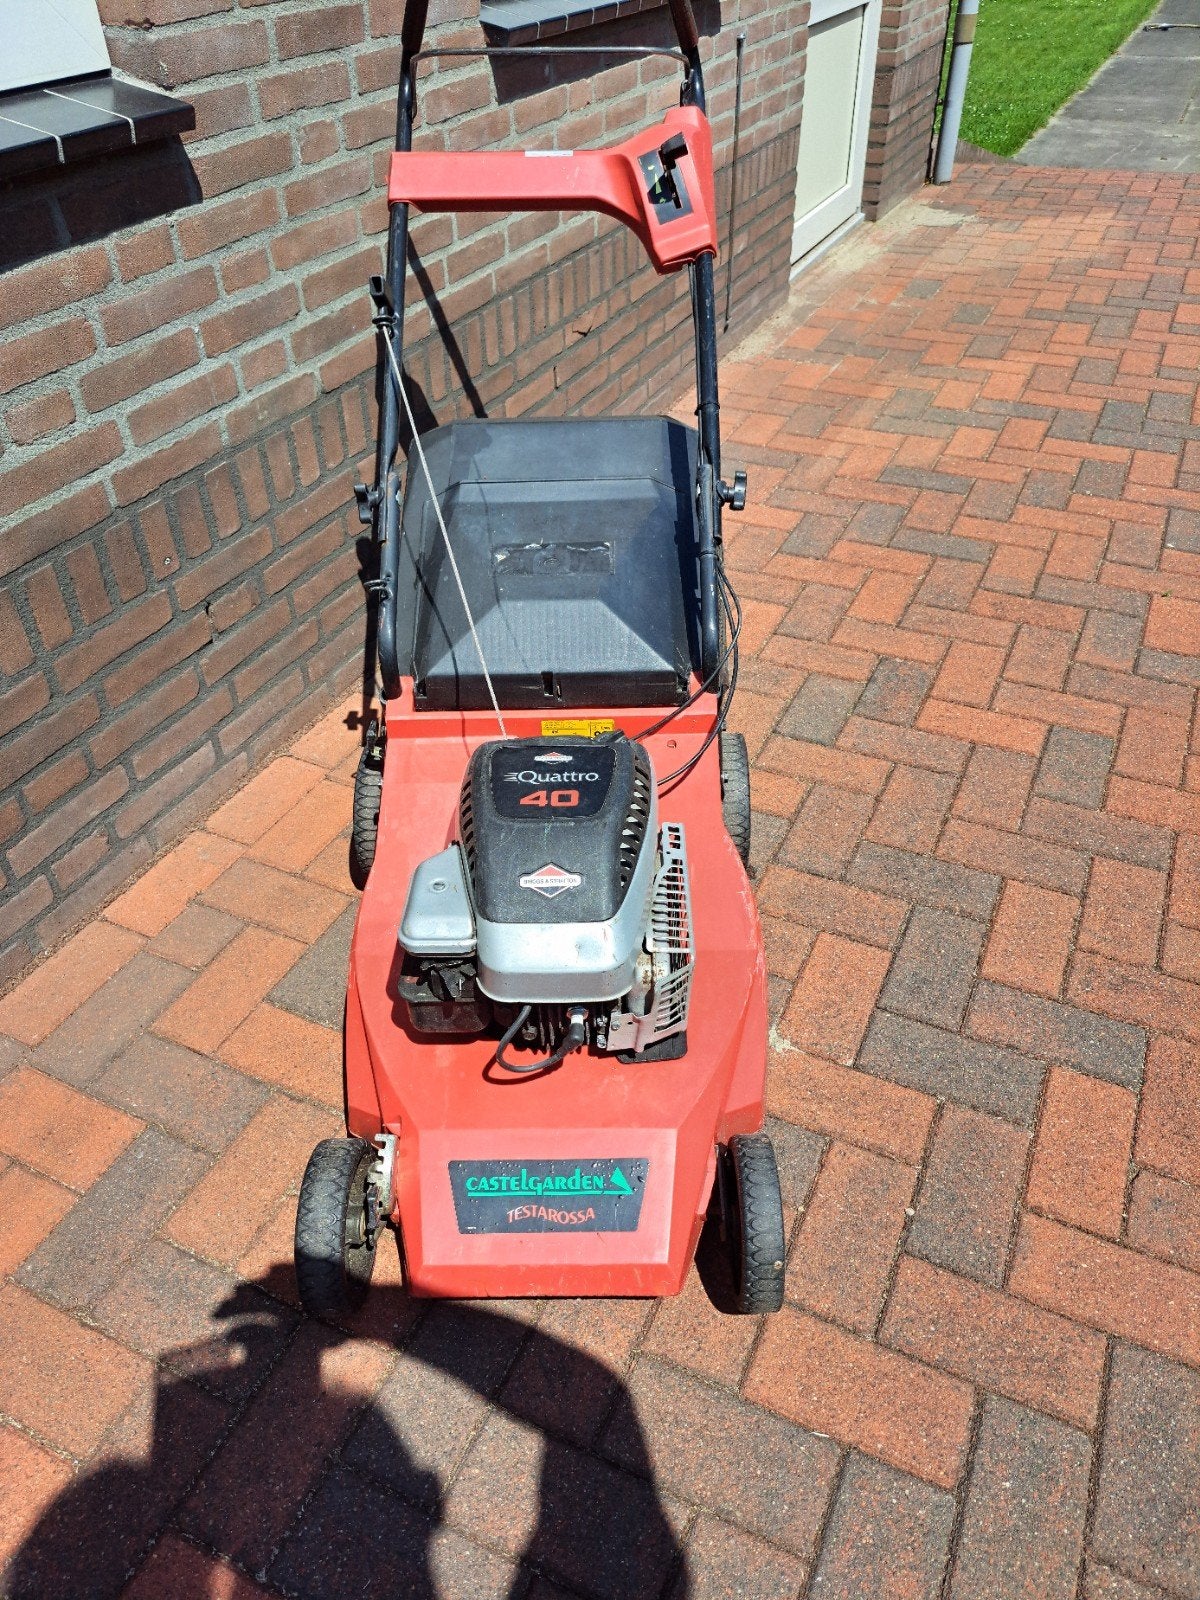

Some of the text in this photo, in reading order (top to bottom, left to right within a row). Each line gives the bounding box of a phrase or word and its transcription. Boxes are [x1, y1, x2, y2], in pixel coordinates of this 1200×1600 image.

[517, 770, 599, 785] Quattro
[519, 789, 580, 808] 40
[506, 1204, 596, 1225] TESTAROSSA
